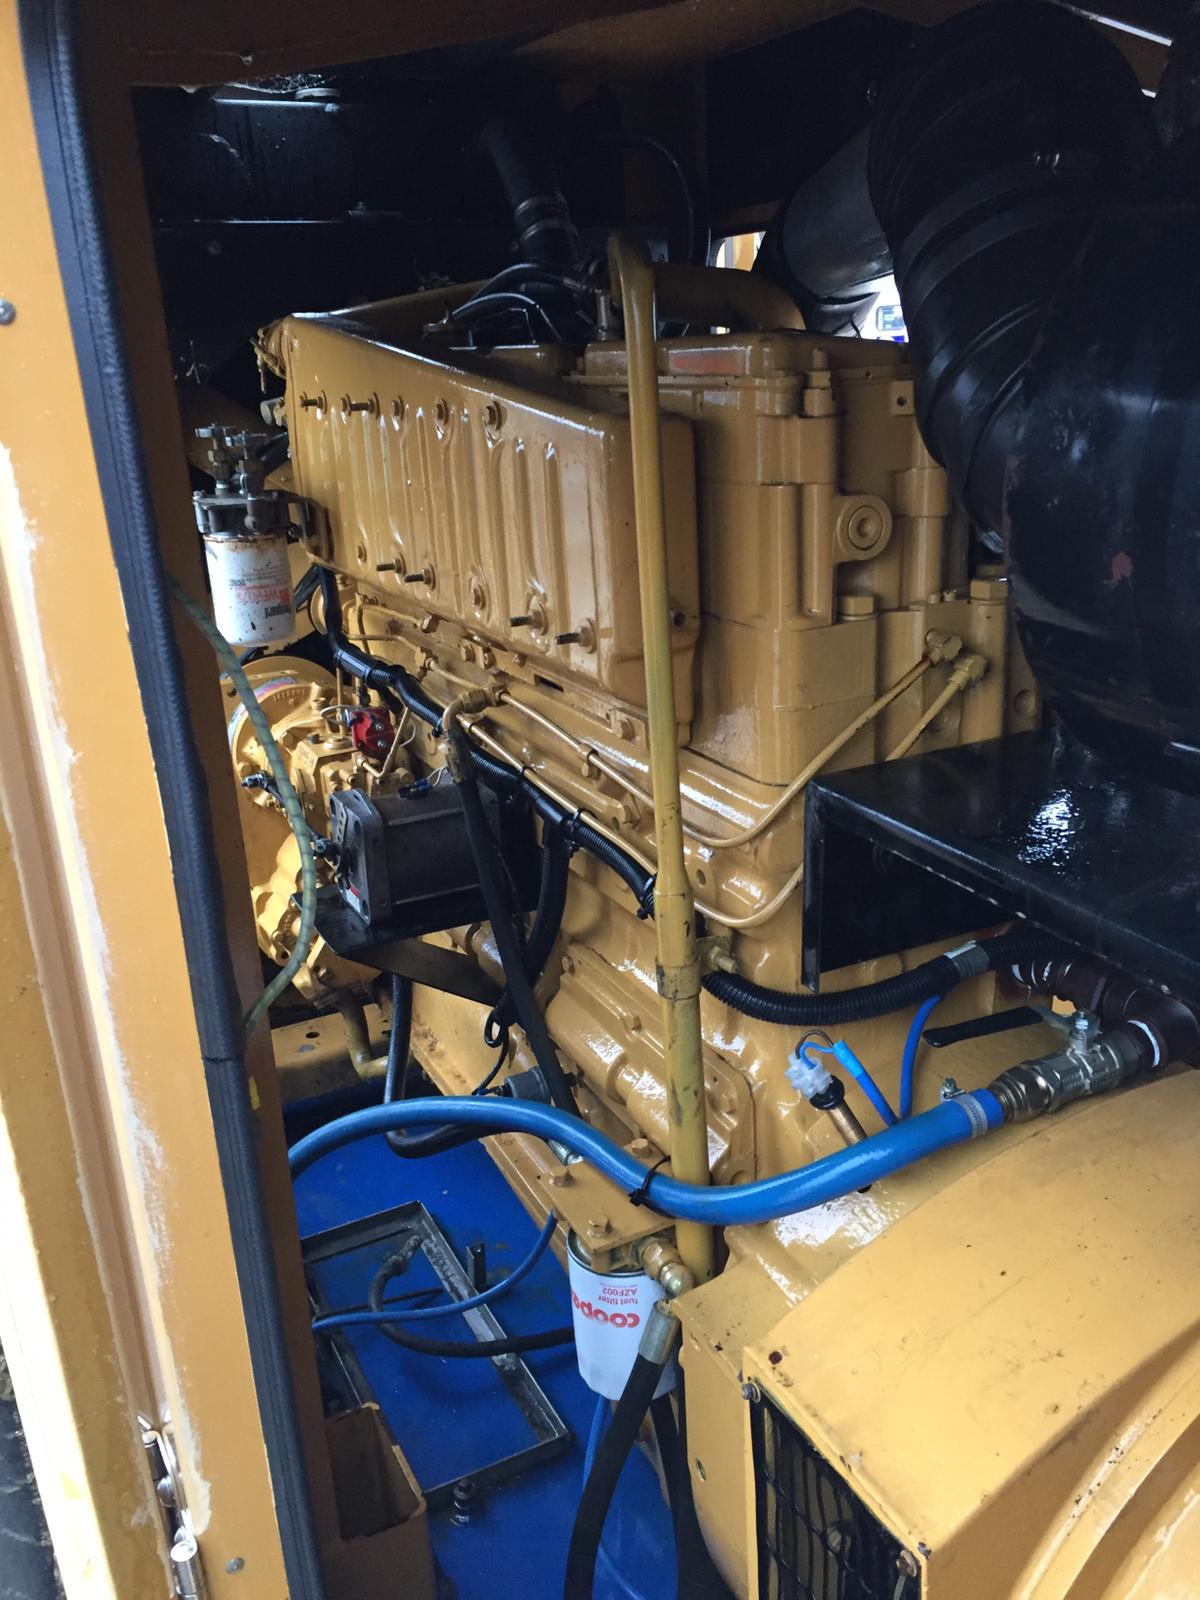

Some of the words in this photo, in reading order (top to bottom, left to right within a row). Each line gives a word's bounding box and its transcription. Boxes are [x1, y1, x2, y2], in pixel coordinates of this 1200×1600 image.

[602, 1287, 638, 1297] AZF002
[598, 1295, 618, 1306] filter
[619, 1297, 639, 1306] fuel
